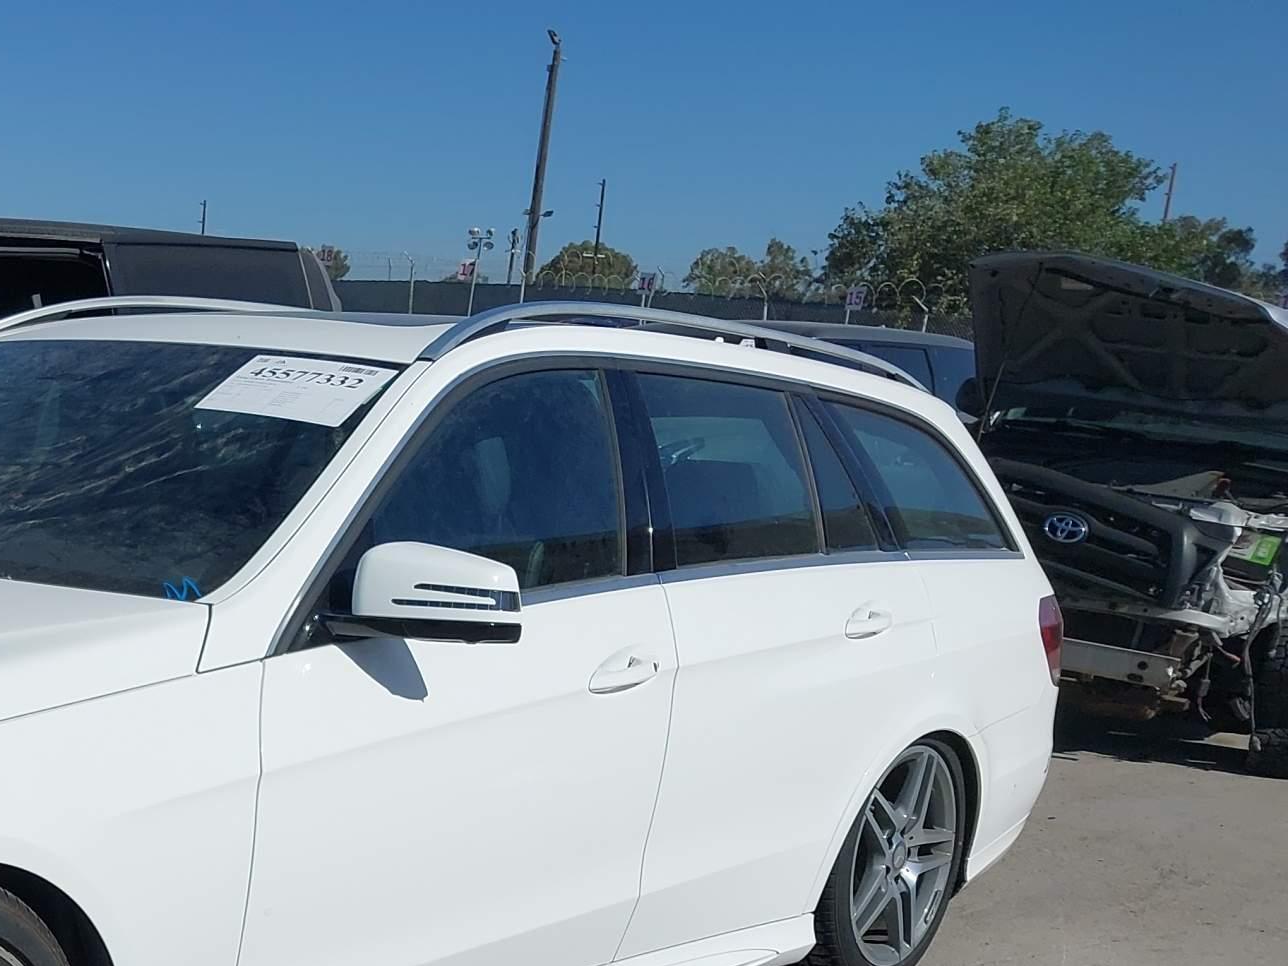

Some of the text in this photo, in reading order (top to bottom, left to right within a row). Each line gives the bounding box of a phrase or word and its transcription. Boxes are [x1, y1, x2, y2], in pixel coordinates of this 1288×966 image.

[459, 262, 476, 277] 17
[847, 290, 864, 305] 15
[250, 367, 364, 389] 45577332
